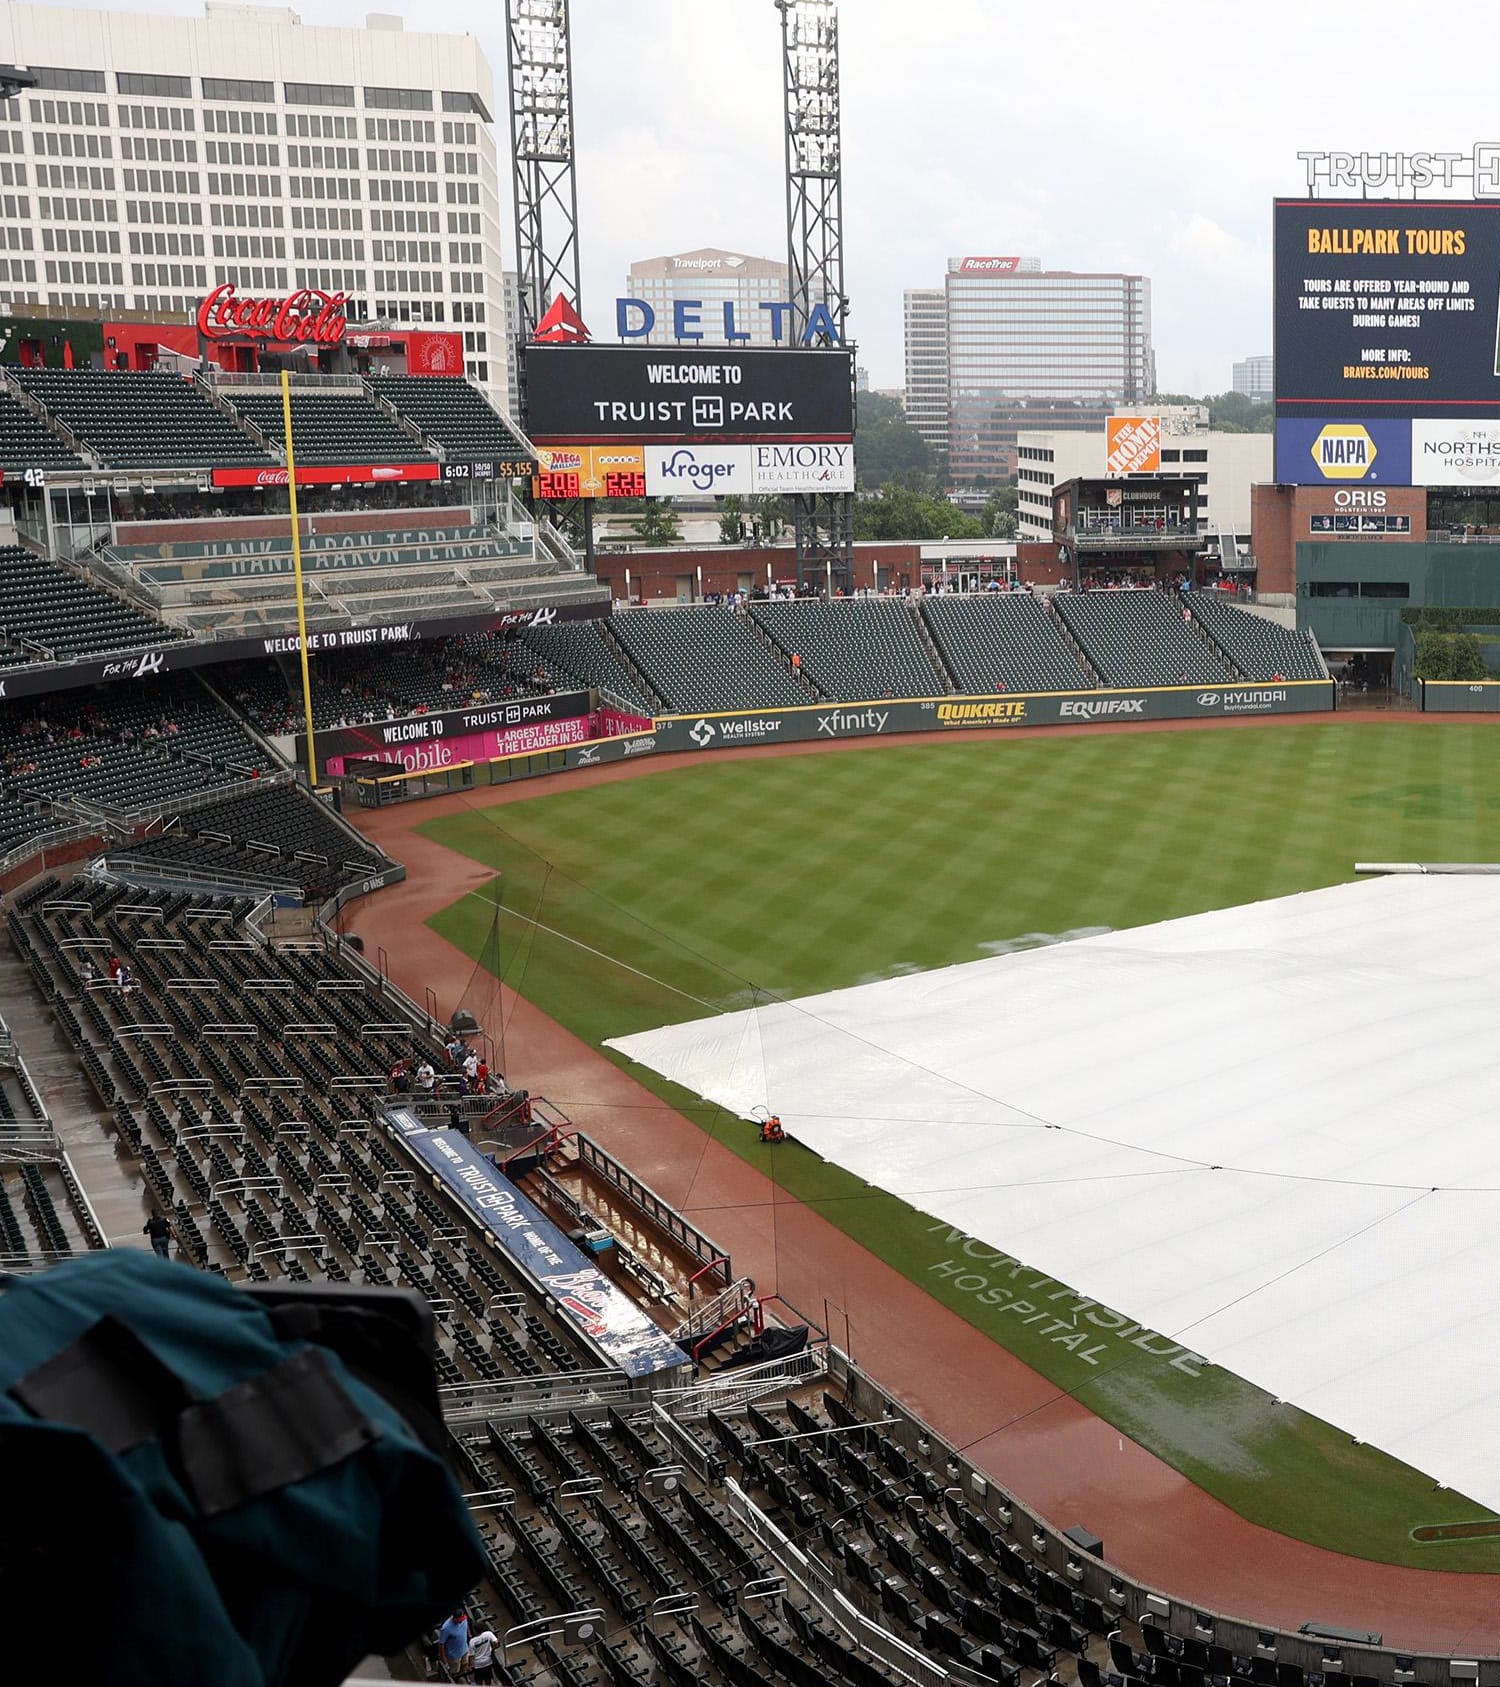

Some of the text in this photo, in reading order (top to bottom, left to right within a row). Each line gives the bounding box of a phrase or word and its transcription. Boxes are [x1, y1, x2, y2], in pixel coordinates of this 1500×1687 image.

[1297, 151, 1462, 187] TRUIST
[1308, 228, 1465, 255] BALLPARK TOURS
[672, 257, 721, 271] Travelport
[964, 259, 1013, 270] RaceTrac
[1304, 279, 1470, 293] TOURS ARE OFFERED YEAR-ROUND AND
[1299, 297, 1475, 312] TAKE GUESTS TO MANY AREAS OFF LIMITS
[616, 298, 840, 342] DELTA
[1353, 315, 1420, 328] DURING GAMES!
[1361, 349, 1411, 361] MORE INFO:
[648, 364, 741, 384] WELCOME TO
[1343, 365, 1429, 380] BRAVES.COM/TOURS
[594, 401, 794, 421] TRUIST PARK
[1112, 422, 1135, 444] THE
[1107, 416, 1160, 471] HOME
[1321, 438, 1367, 465] NAPA
[551, 452, 580, 463] MEGA
[758, 446, 849, 467] EMORY
[1128, 437, 1161, 471] DEPOT
[445, 465, 469, 477] 6:02
[474, 463, 491, 471] 50/50
[474, 470, 492, 478] JACKPOT
[500, 461, 532, 477] $5,155
[662, 450, 735, 490] Kroger
[24, 468, 45, 487] 42
[540, 473, 578, 489] 208
[608, 473, 644, 489] 226
[758, 470, 845, 481] HEALTHCARE
[541, 490, 578, 498] MILLION
[608, 489, 645, 497] MILLION
[1123, 491, 1161, 500] CLUBHOUSE
[1334, 490, 1387, 506] ORIS
[322, 633, 336, 647] TO
[339, 629, 378, 645] TRUIST
[381, 625, 409, 641] PARK
[1224, 690, 1286, 703] HYUNDAI
[937, 702, 1025, 720] QUIKRETE
[1059, 699, 1145, 719] EQUIFAX
[384, 704, 551, 743] WELCOME TO TRUIST PARK
[656, 722, 672, 730] 375
[719, 719, 781, 734] Wellstar
[817, 708, 889, 737] xfinity
[497, 720, 584, 743] LARGEST. FASTEST.
[498, 731, 584, 754] THE LEADER IN 5G
[456, 1165, 498, 1197] TRUIST
[494, 1203, 531, 1229] PARK
[928, 1260, 1108, 1365] HOSPITAL
